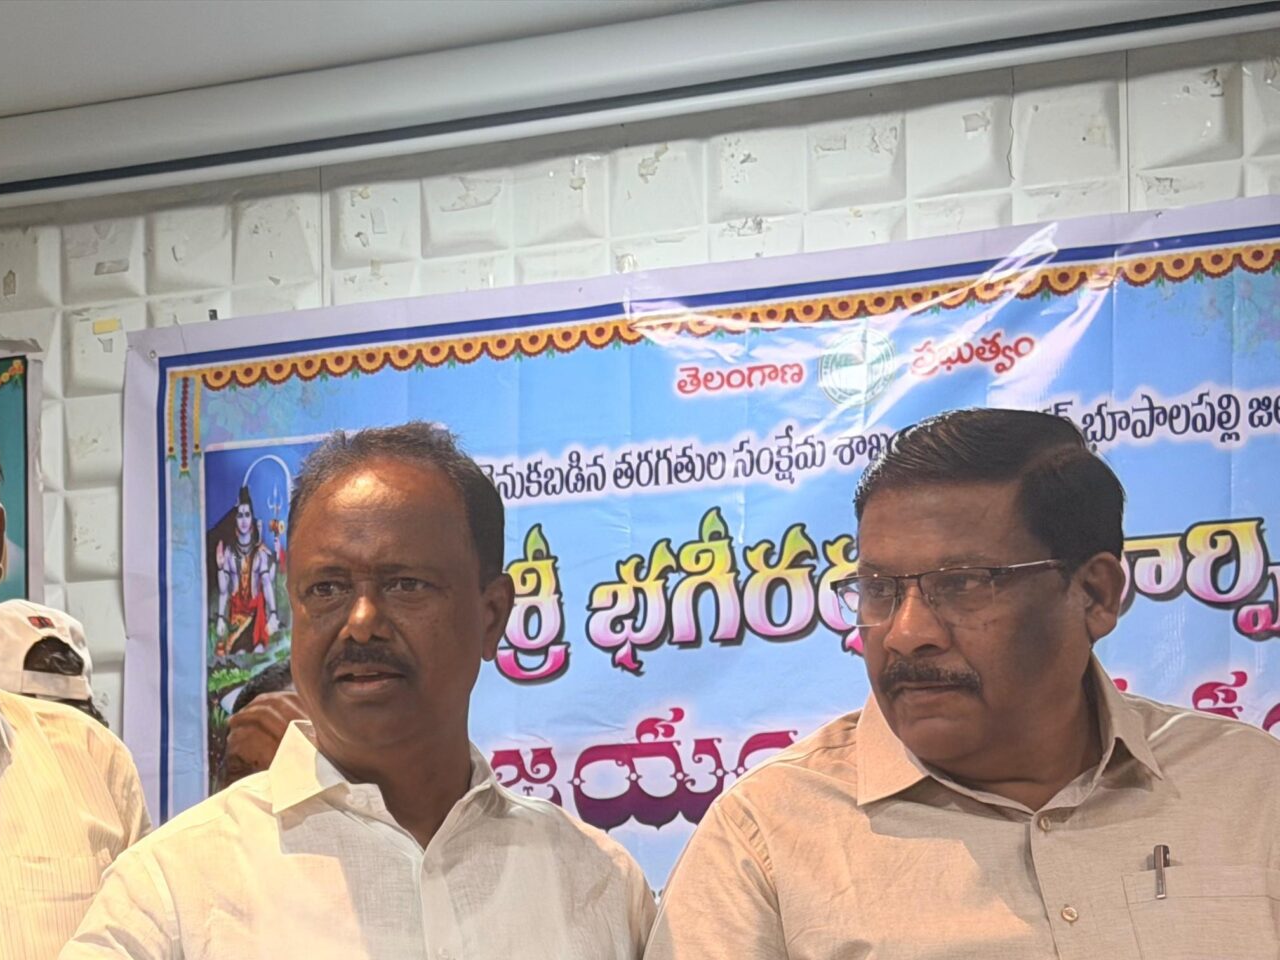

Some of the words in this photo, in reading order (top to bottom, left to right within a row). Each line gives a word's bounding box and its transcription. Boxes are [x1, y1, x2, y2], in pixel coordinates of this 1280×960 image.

[677, 361, 804, 394] తెలంగాణ
[911, 332, 1036, 377] ప్రభుత్వం
[1080, 390, 1242, 446] భూపాలపల్లి
[612, 443, 727, 489] తరగతుల
[732, 424, 827, 484] సంక్షేమ
[494, 523, 571, 682] శ్రీ
